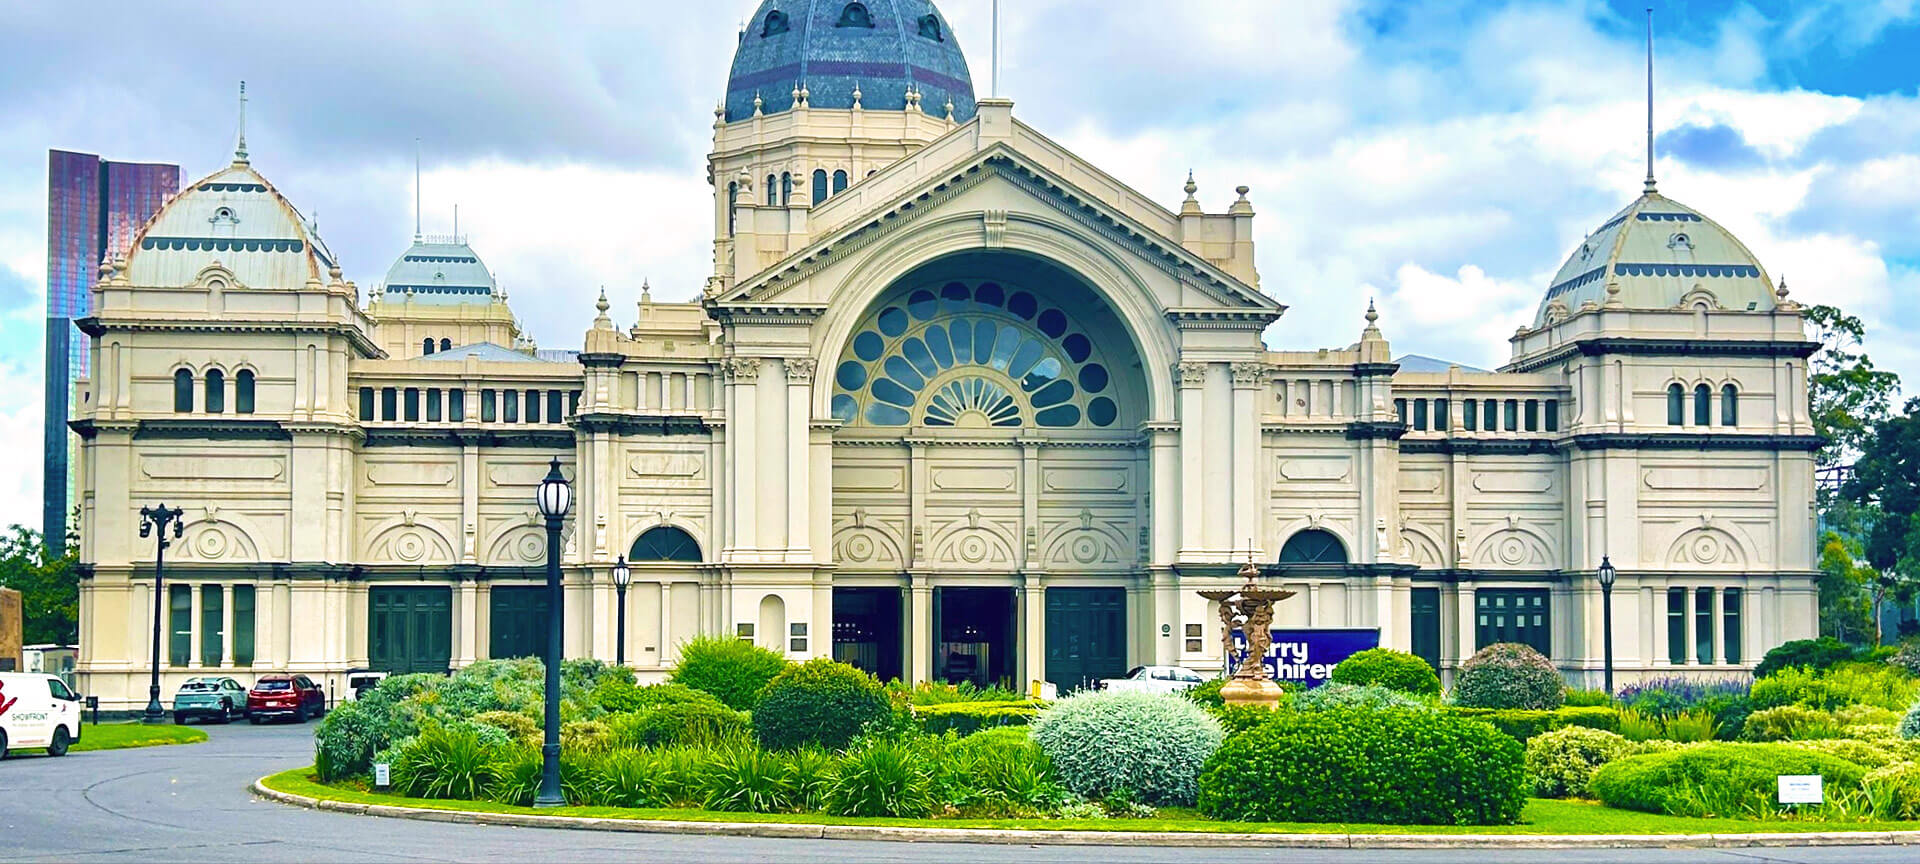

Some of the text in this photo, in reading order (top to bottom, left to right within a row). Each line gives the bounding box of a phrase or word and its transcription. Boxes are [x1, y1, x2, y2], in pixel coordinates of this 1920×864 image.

[1234, 637, 1308, 663] Hrry
[1276, 657, 1338, 679] hirer
[12, 713, 48, 721] SHOWFRONT
